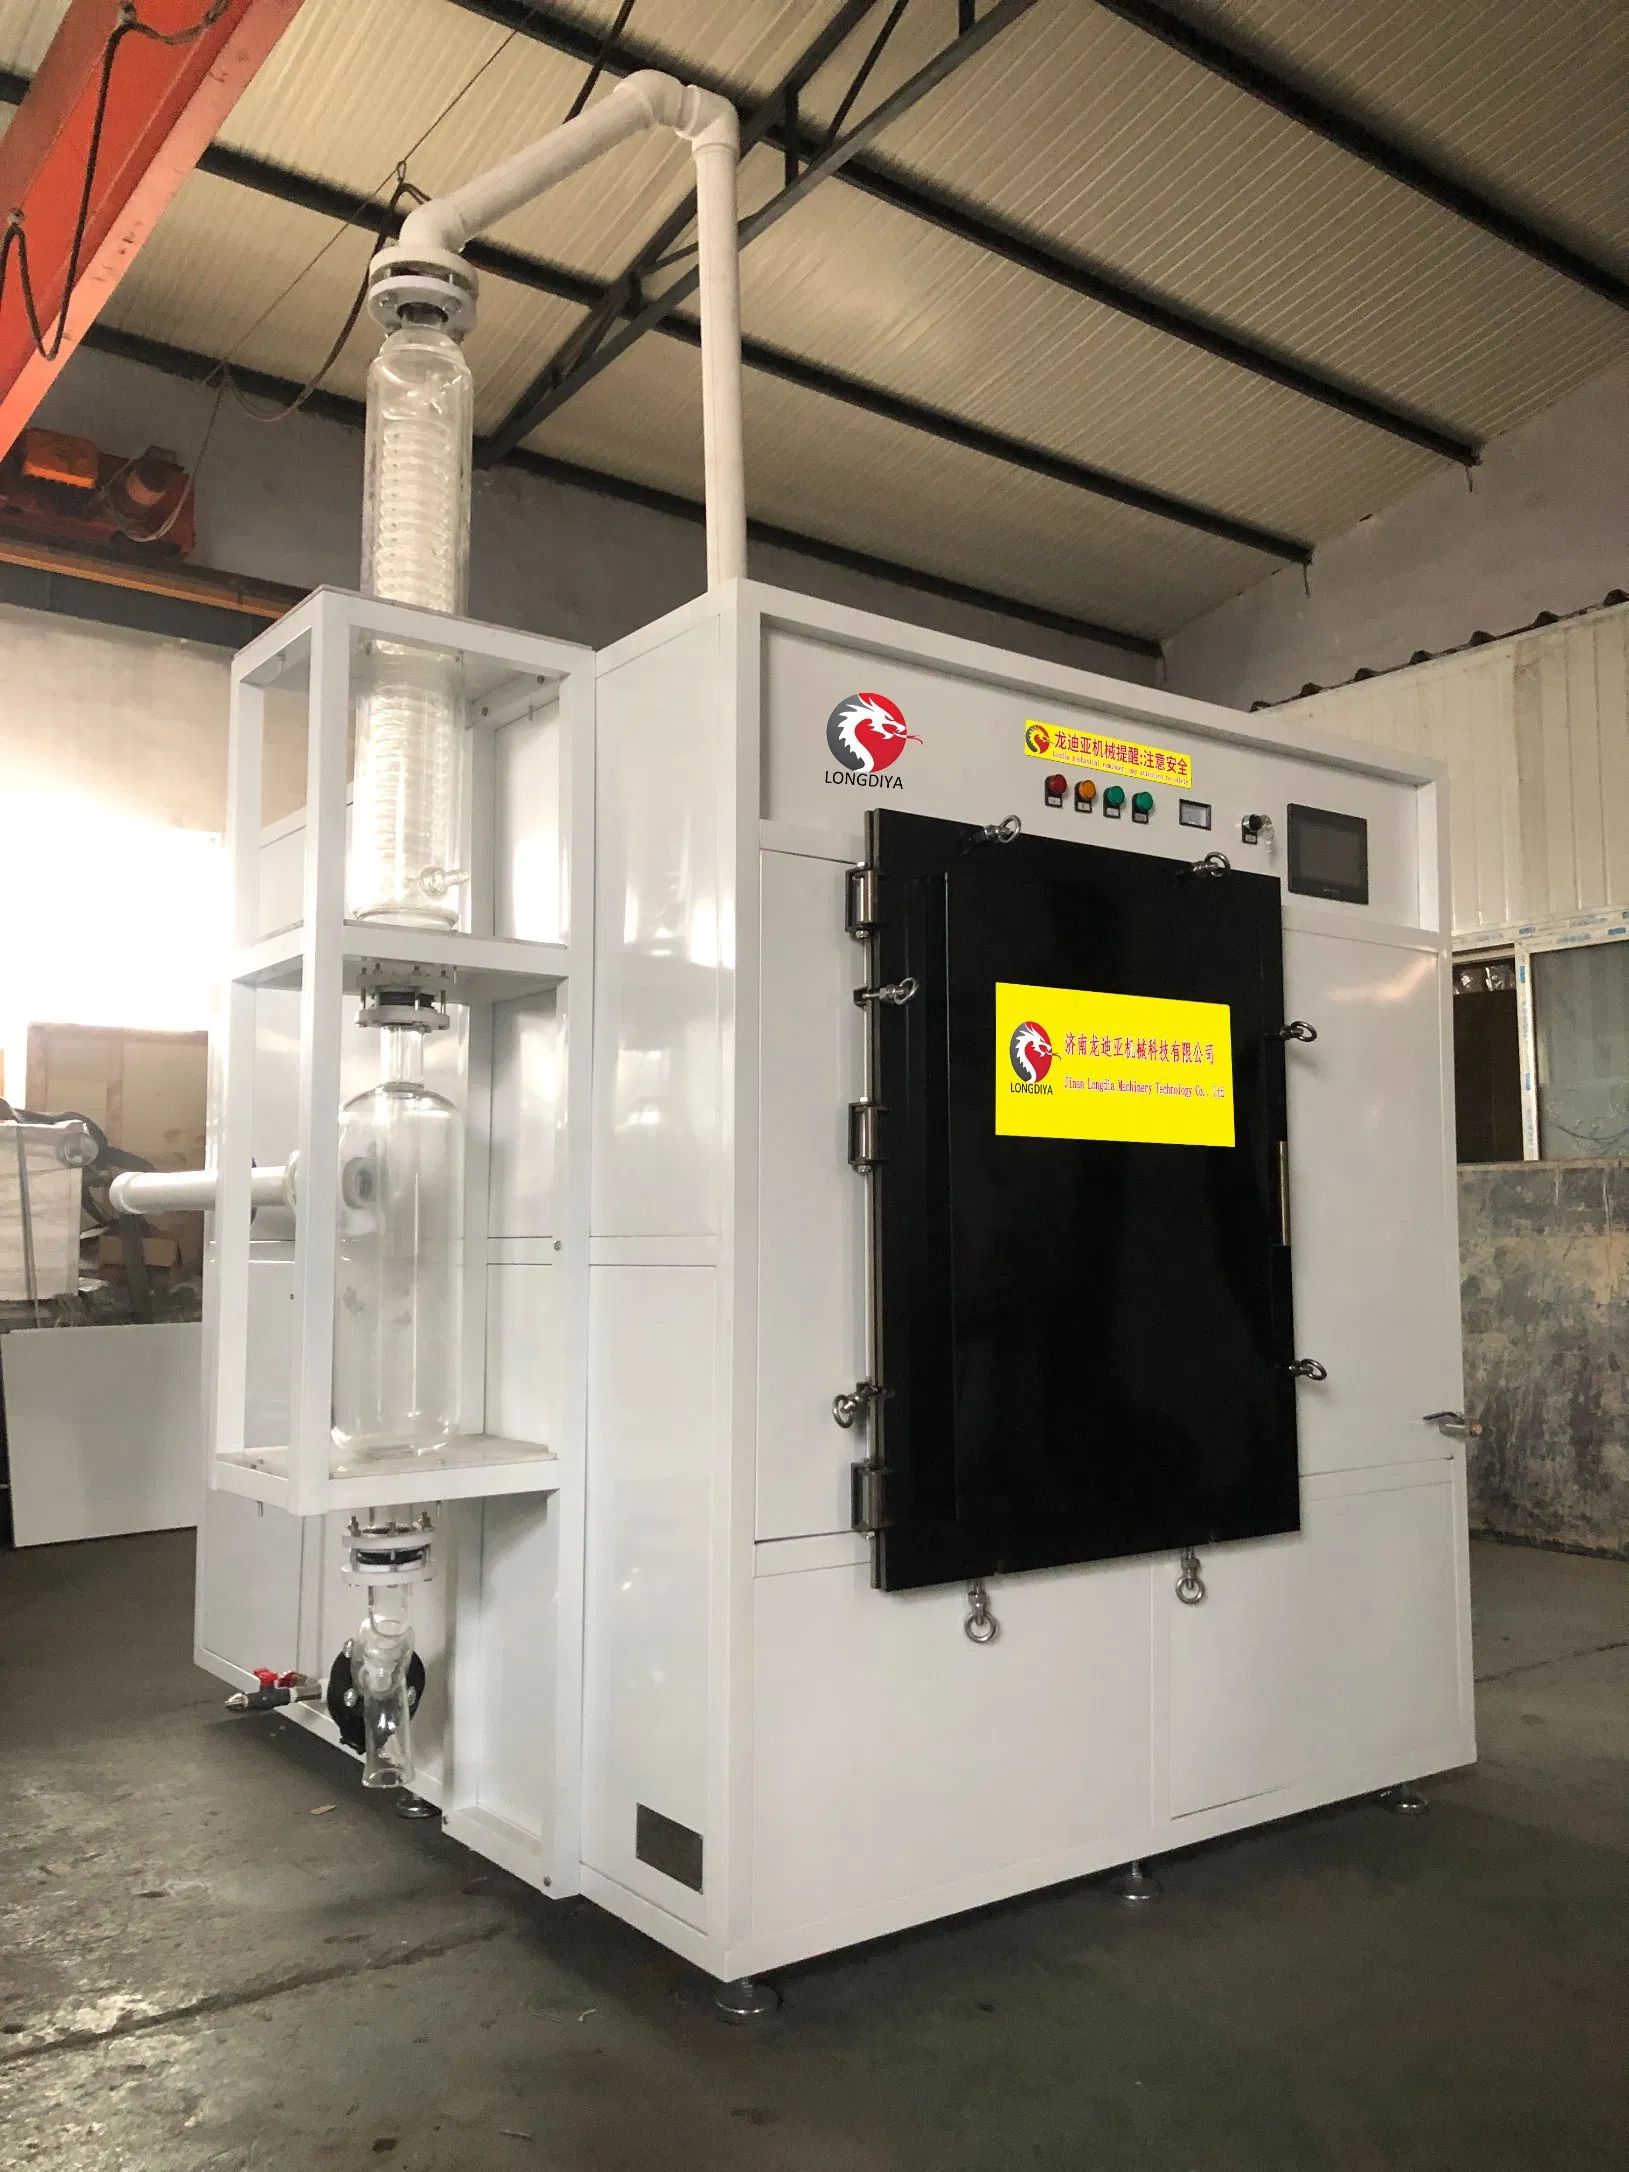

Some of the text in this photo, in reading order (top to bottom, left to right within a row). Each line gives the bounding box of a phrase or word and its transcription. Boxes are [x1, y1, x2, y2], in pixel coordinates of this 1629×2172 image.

[825, 771, 904, 790] LONGDIYA
[1064, 1031, 1214, 1065] 济南龙迪亚机械科技有限公司
[1010, 1082, 1054, 1096] LONGDIYA
[1064, 1076, 1085, 1090] Jinan
[1087, 1077, 1115, 1093] Longdia
[1117, 1079, 1152, 1096] Machinery
[1155, 1081, 1193, 1098] Technology
